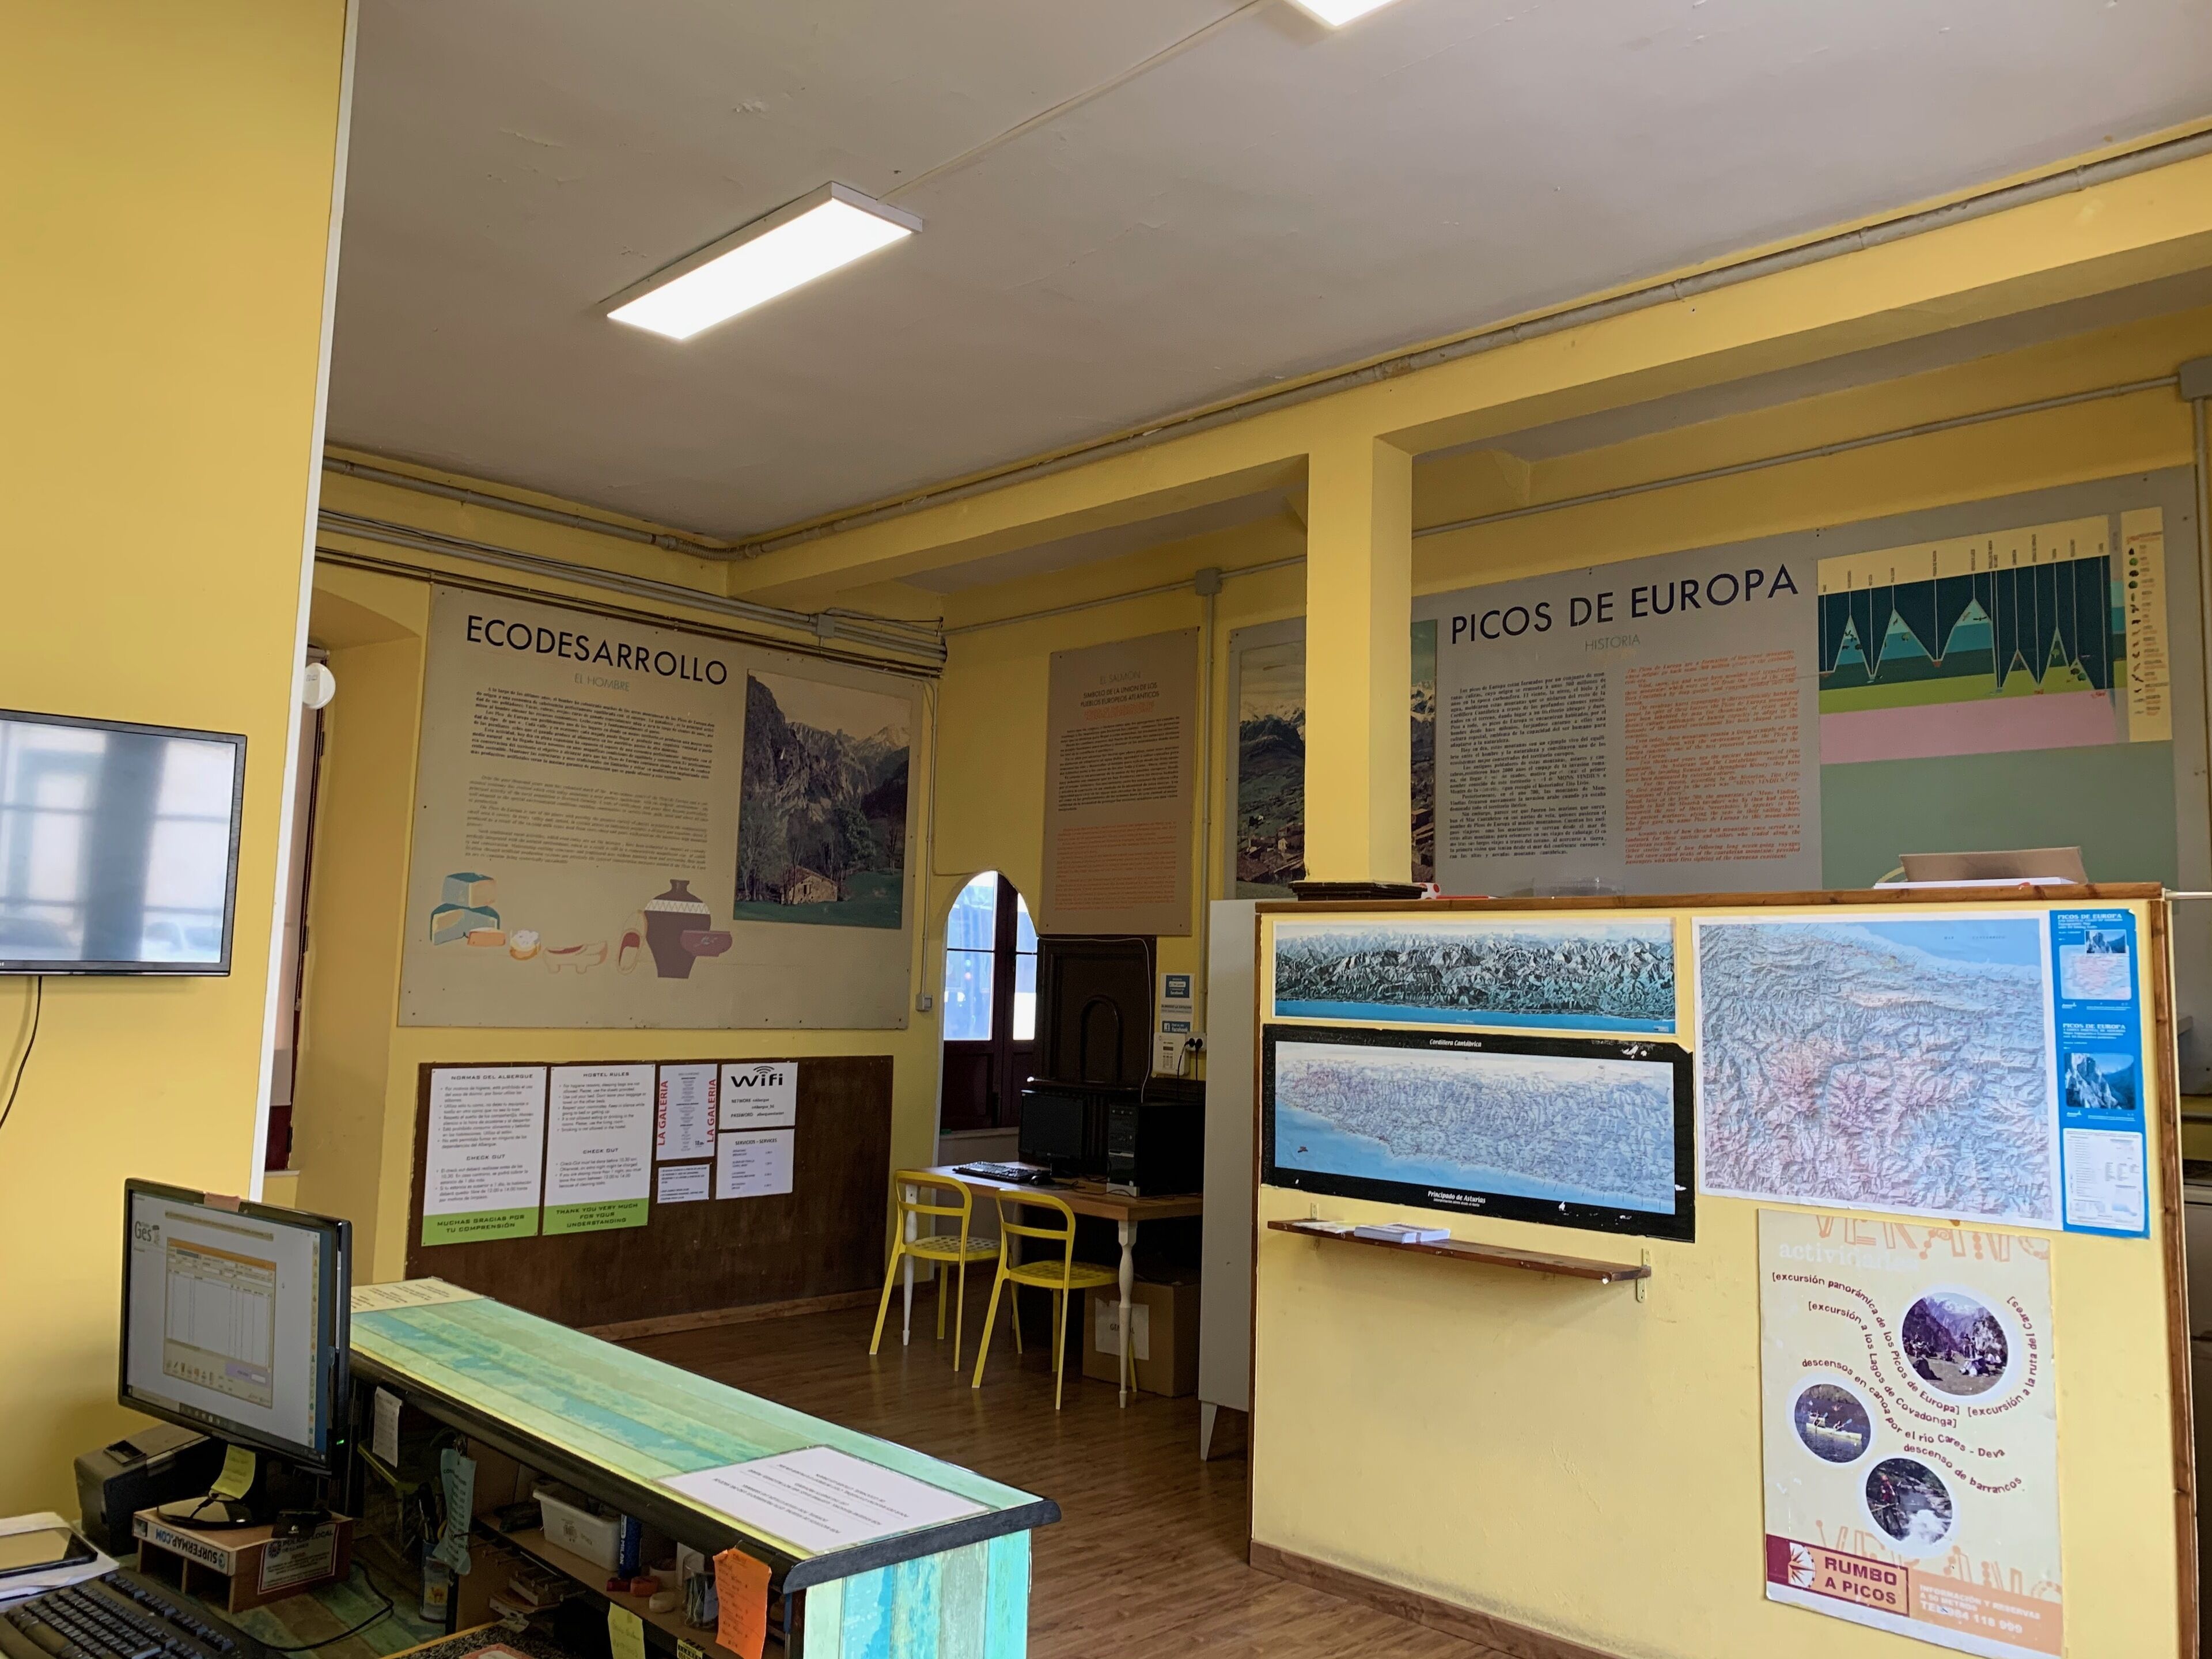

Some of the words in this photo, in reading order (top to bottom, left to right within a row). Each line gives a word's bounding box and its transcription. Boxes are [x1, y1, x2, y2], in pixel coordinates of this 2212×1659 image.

[1452, 603, 1551, 644] PICOS
[1569, 592, 1613, 627] DE
[1630, 563, 1798, 618] EUROPA
[467, 615, 728, 685] ECODESARROLLO
[1585, 634, 1640, 652] HISTORIA
[574, 673, 583, 684] EL
[586, 676, 630, 692] HOMBRE
[731, 1073, 783, 1088] Wifi
[658, 1080, 668, 1129] GALERIA
[707, 1079, 716, 1126] GALERIA
[658, 1131, 666, 1146] LA
[707, 1128, 715, 1143] LA
[1428, 1190, 1456, 1200] Principado
[1464, 1195, 1486, 1203] Asturias
[437, 1218, 471, 1226] MUCHAS
[567, 1218, 627, 1228] UNDERSTANDING
[2006, 1296, 2032, 1330] Cares]
[1772, 1272, 1825, 1285] [excursión
[1828, 1280, 1878, 1315] panorámica
[1876, 1316, 1886, 1328] de
[1884, 1331, 1894, 1347] los
[1891, 1350, 1908, 1378] Picos
[1907, 1381, 1918, 1392] de
[1920, 1391, 1960, 1415] Europa]
[2025, 1332, 2037, 1350] del
[1808, 1301, 1862, 1324] [excursión
[1865, 1334, 1873, 1350] los
[1870, 1353, 1885, 1384] Lagos
[1884, 1385, 1895, 1397] de
[1896, 1397, 1957, 1429] Covadonga]
[2029, 1353, 2037, 1376] ruta
[2025, 1378, 2036, 1387] la
[1802, 1358, 1853, 1376] descensos
[1855, 1376, 1867, 1388] en
[1869, 1387, 1891, 1414] canoa
[1885, 1417, 1903, 1433] por
[1906, 1431, 1915, 1440] el
[1919, 1433, 1934, 1443] río
[1938, 1434, 1966, 1452] Cares
[1978, 1448, 2005, 1458] Deva
[1968, 1395, 2024, 1418] [excursión
[1904, 1444, 1953, 1468] descenso
[1955, 1469, 1967, 1480] de
[1969, 1477, 2022, 1494] barrancos
[156, 1528, 217, 1564] SURFERMAP.COM
[1825, 1556, 1897, 1586] RUMBO
[1825, 1577, 1836, 1589] A
[1842, 1583, 1896, 1605] PICOS
[1973, 1613, 1995, 1627] 118
